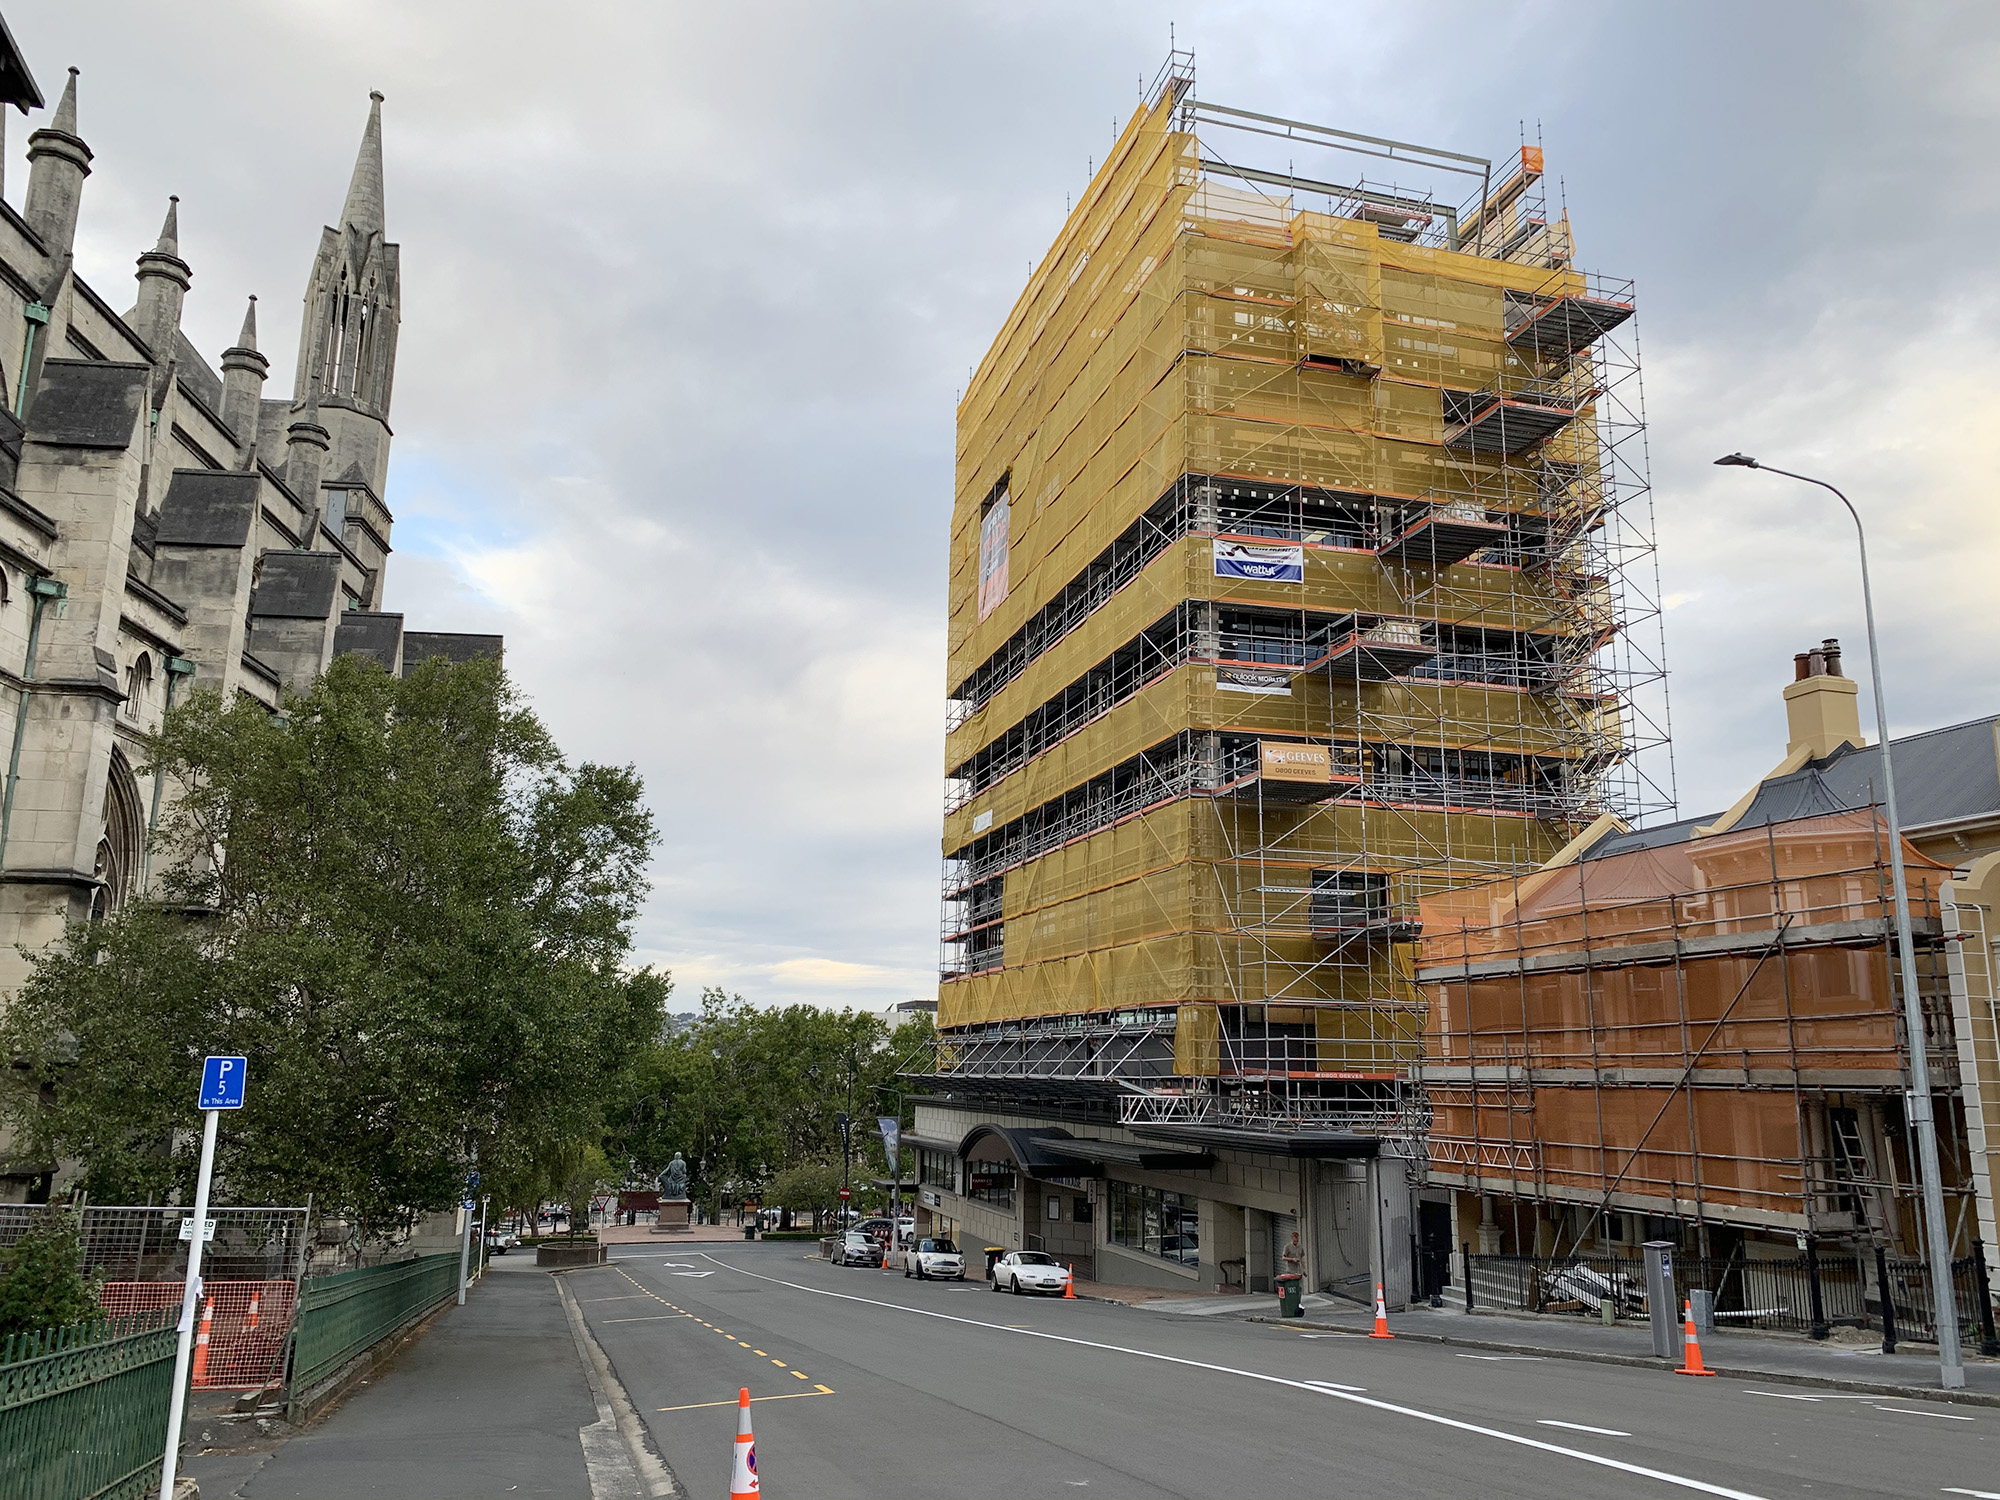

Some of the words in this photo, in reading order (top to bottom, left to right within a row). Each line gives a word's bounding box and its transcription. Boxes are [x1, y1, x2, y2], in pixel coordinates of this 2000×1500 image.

[1286, 751, 1325, 763] GEEVES
[219, 1060, 233, 1079] P
[217, 1080, 226, 1095] 5
[211, 1097, 223, 1105] This
[224, 1097, 239, 1105] Area
[184, 1220, 214, 1228] UNED
[1662, 1254, 1669, 1264] P
